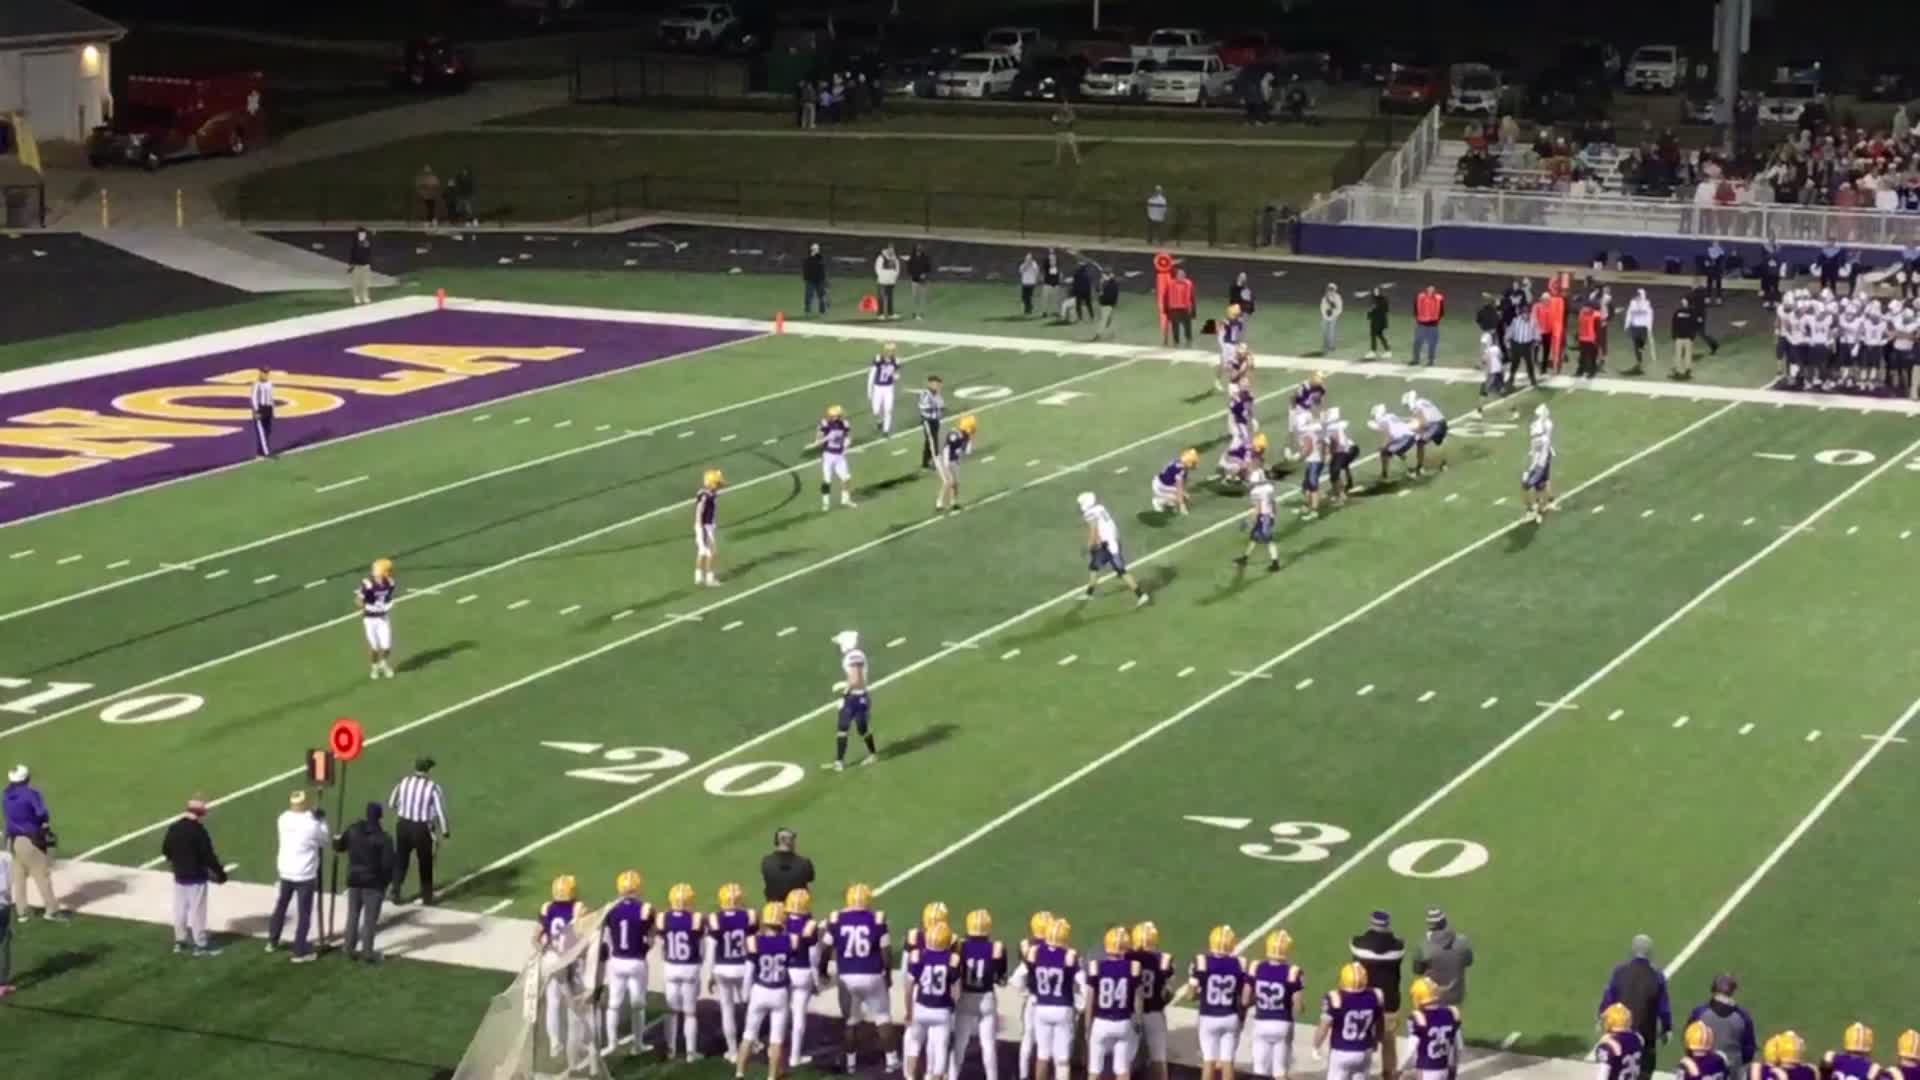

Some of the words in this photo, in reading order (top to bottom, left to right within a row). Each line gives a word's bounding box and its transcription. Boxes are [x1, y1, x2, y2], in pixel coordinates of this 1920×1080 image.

[312, 751, 326, 781] 1
[619, 919, 630, 950] 1
[666, 931, 691, 960] 16
[723, 929, 747, 959] 13
[840, 925, 871, 958] 76
[919, 965, 948, 996] 43
[1035, 967, 1064, 997] 87
[1099, 976, 1128, 1009] 84
[1206, 974, 1236, 1006] 62
[1254, 980, 1285, 1010] 52
[1341, 1009, 1374, 1041] 67
